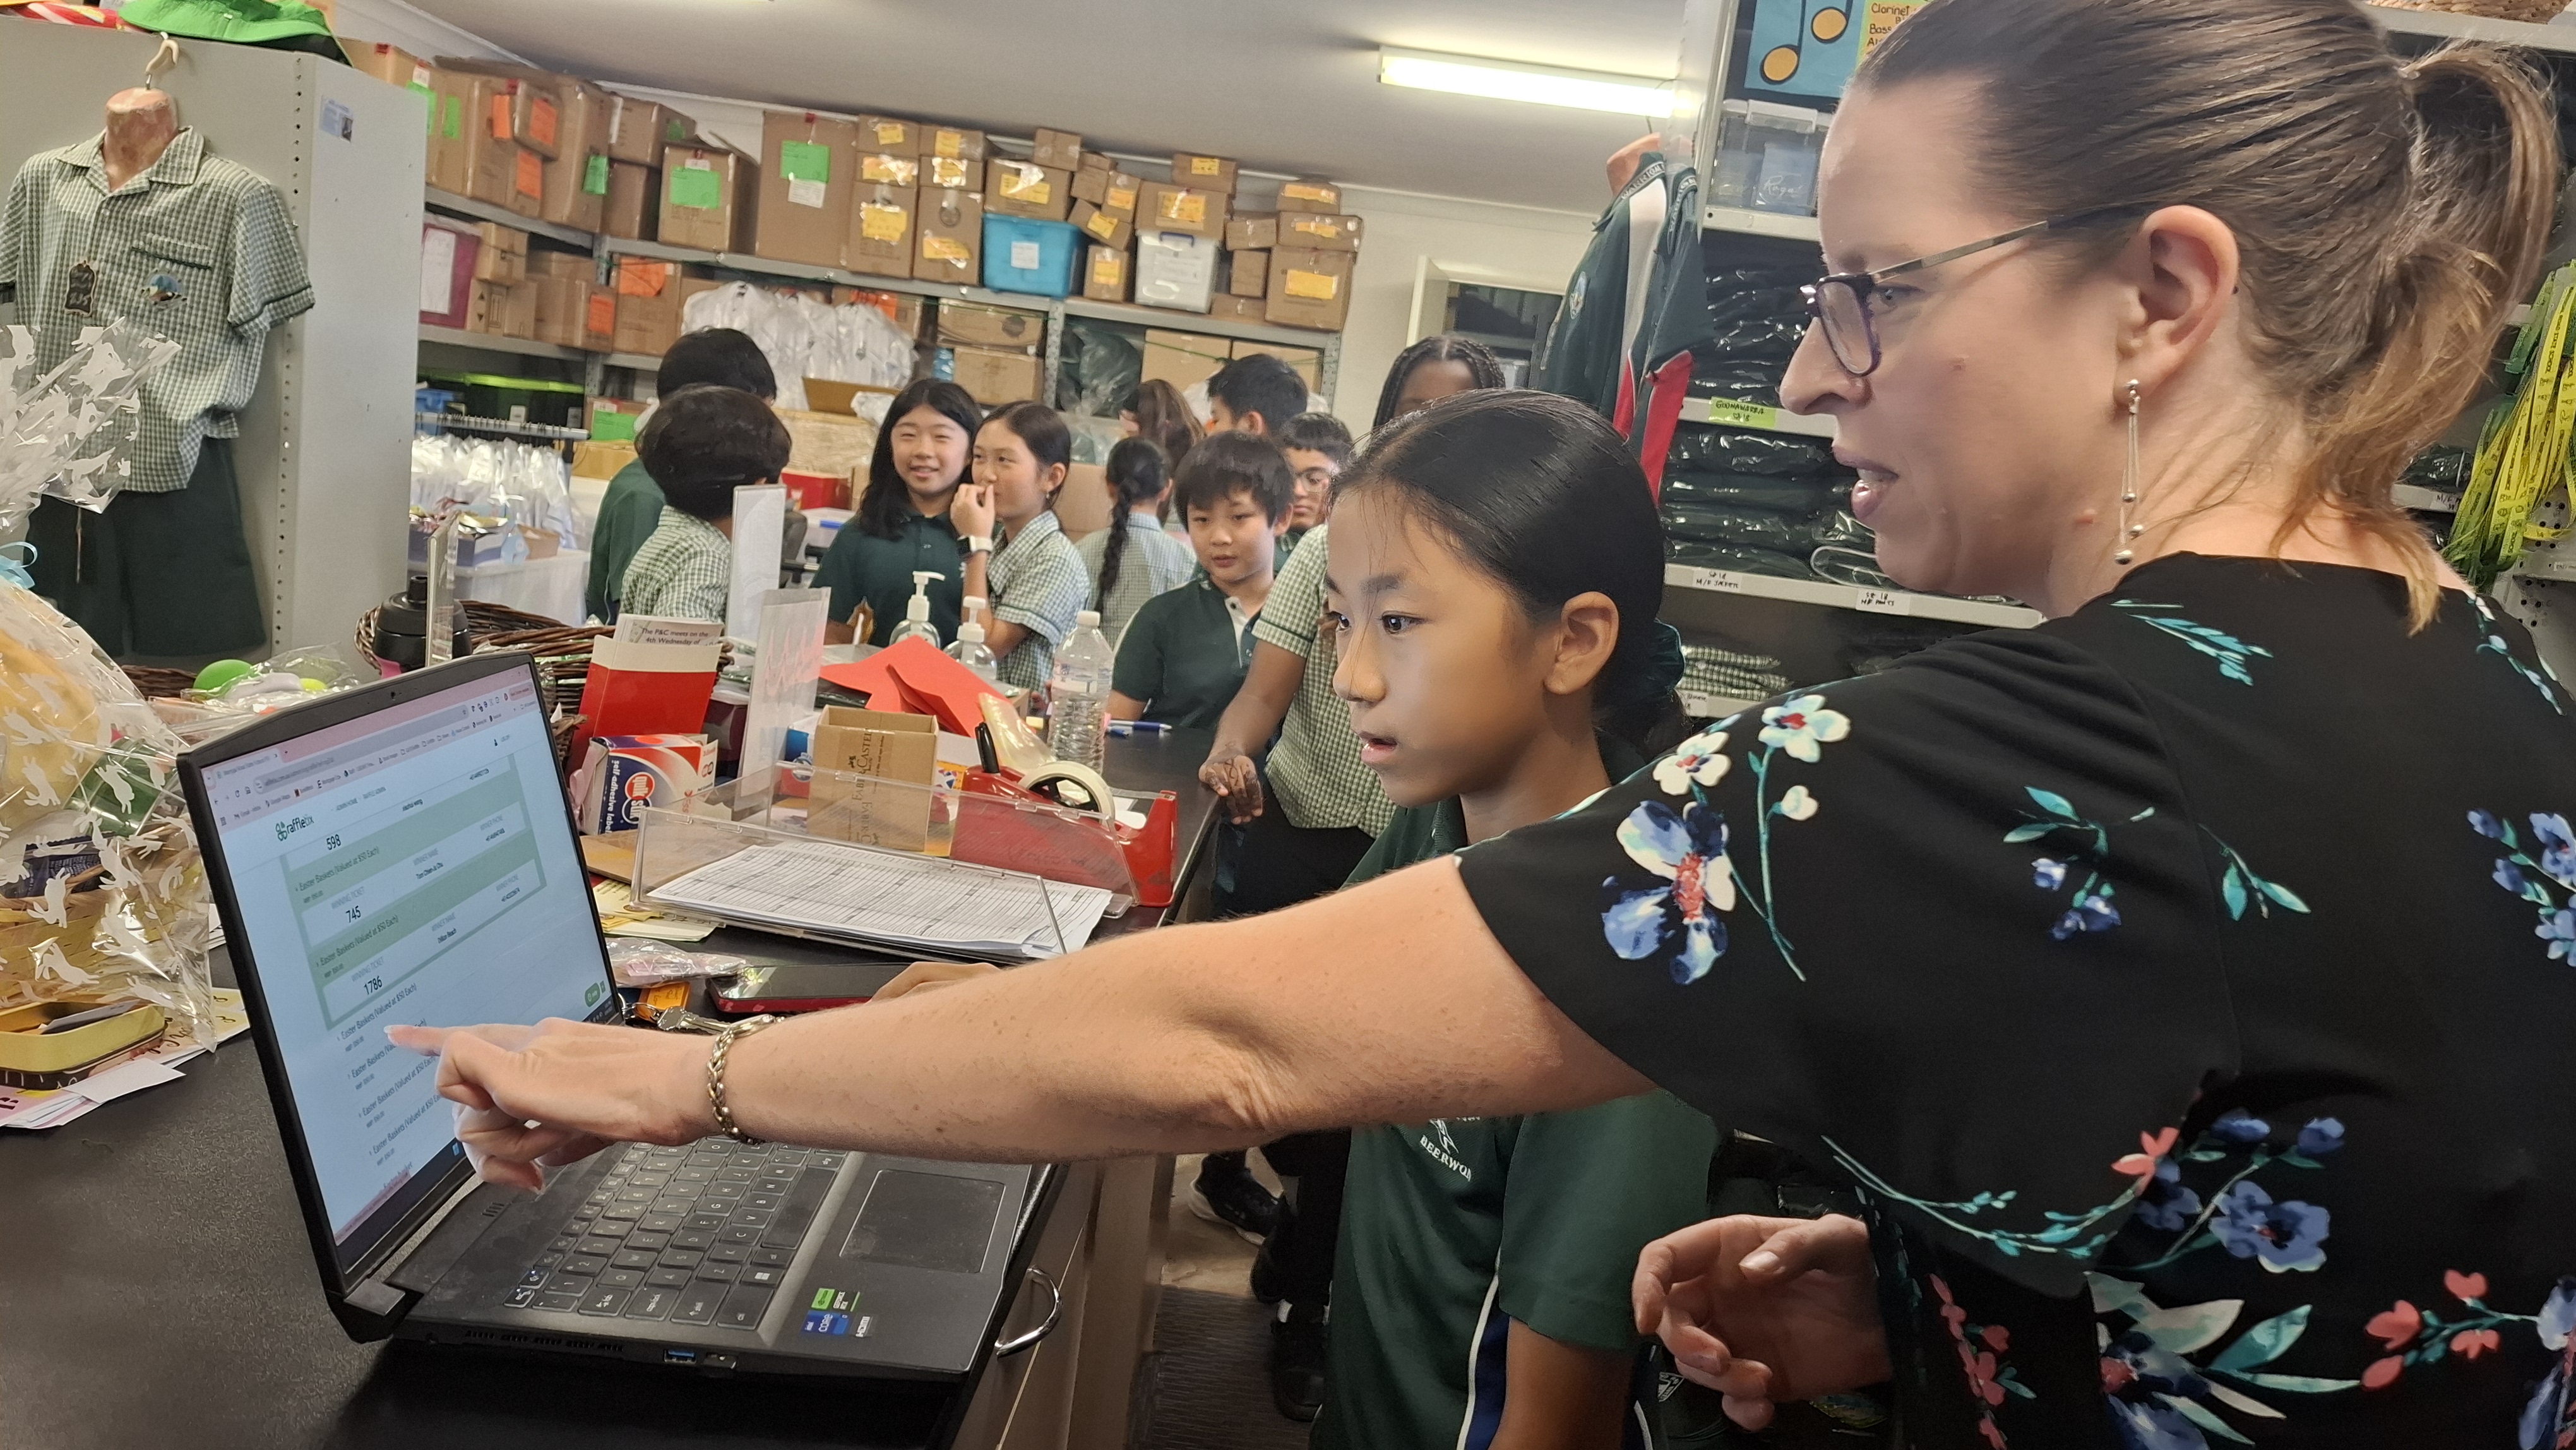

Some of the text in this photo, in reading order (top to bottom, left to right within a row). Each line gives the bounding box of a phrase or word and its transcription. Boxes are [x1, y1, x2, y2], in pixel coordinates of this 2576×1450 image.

[659, 637, 693, 645] Wednesday
[852, 728, 872, 800] FABR CASTEL
[286, 815, 314, 834] raffletix
[605, 813, 615, 834] label
[326, 834, 342, 851] 598
[346, 905, 362, 923] 745
[364, 976, 383, 995] 1786
